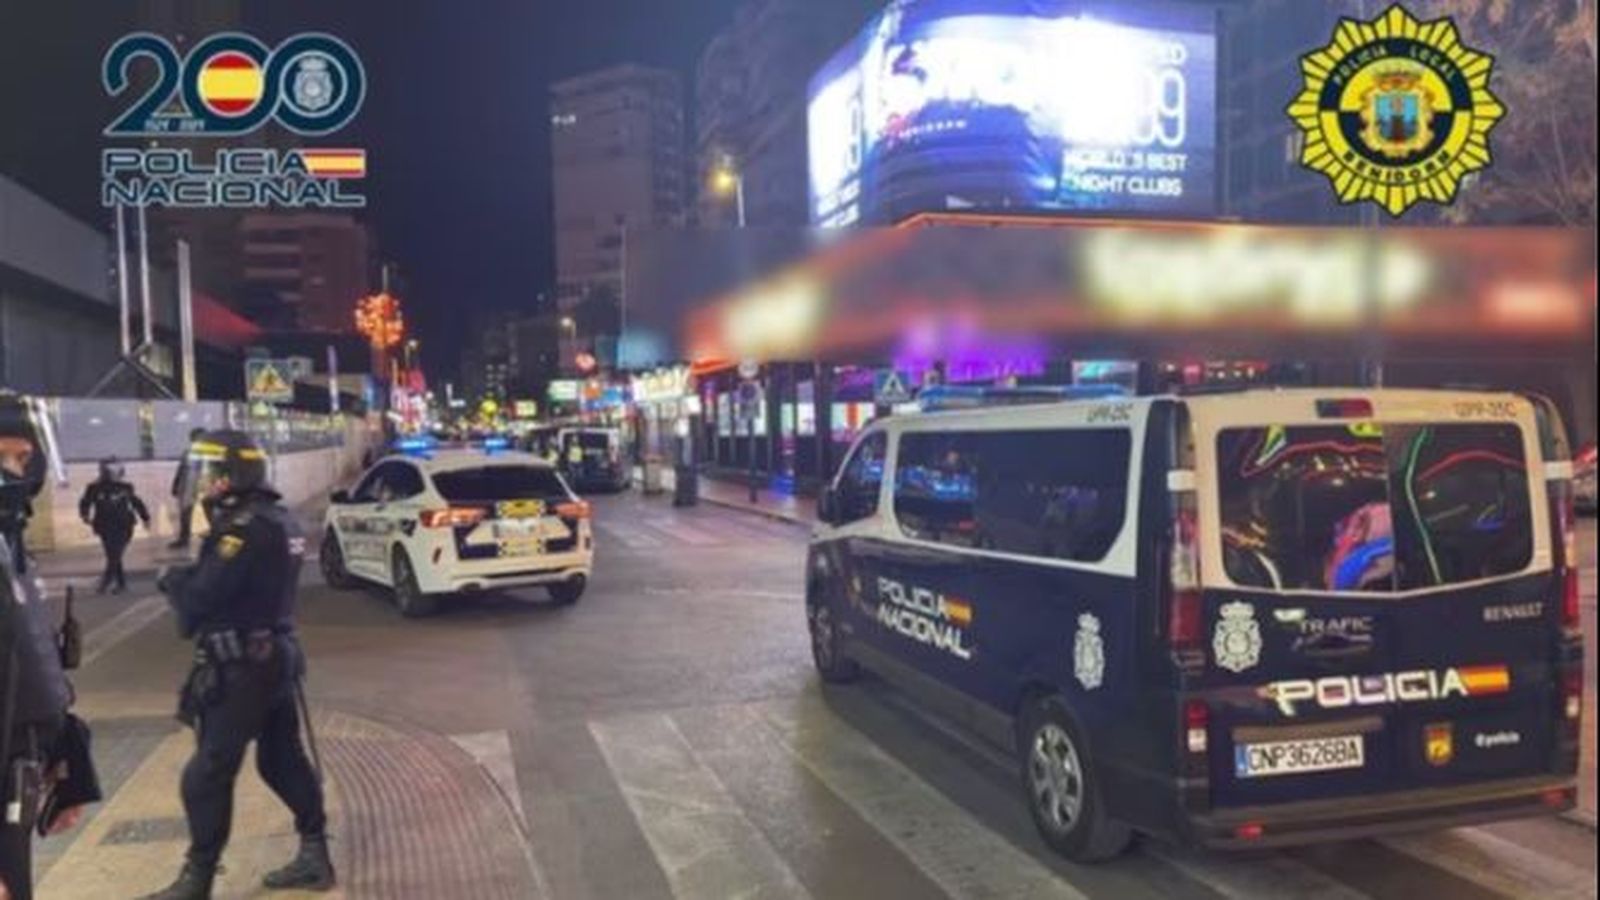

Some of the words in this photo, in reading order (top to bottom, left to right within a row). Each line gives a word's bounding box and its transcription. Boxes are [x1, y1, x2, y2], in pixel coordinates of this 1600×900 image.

[1128, 177, 1183, 196] CLUBS
[877, 576, 950, 622] POLICIA
[1484, 603, 1542, 621] RENAULT
[877, 600, 971, 660] NACIONAL
[1301, 616, 1373, 634] TRAFIC
[1275, 667, 1469, 716] POLICIA
